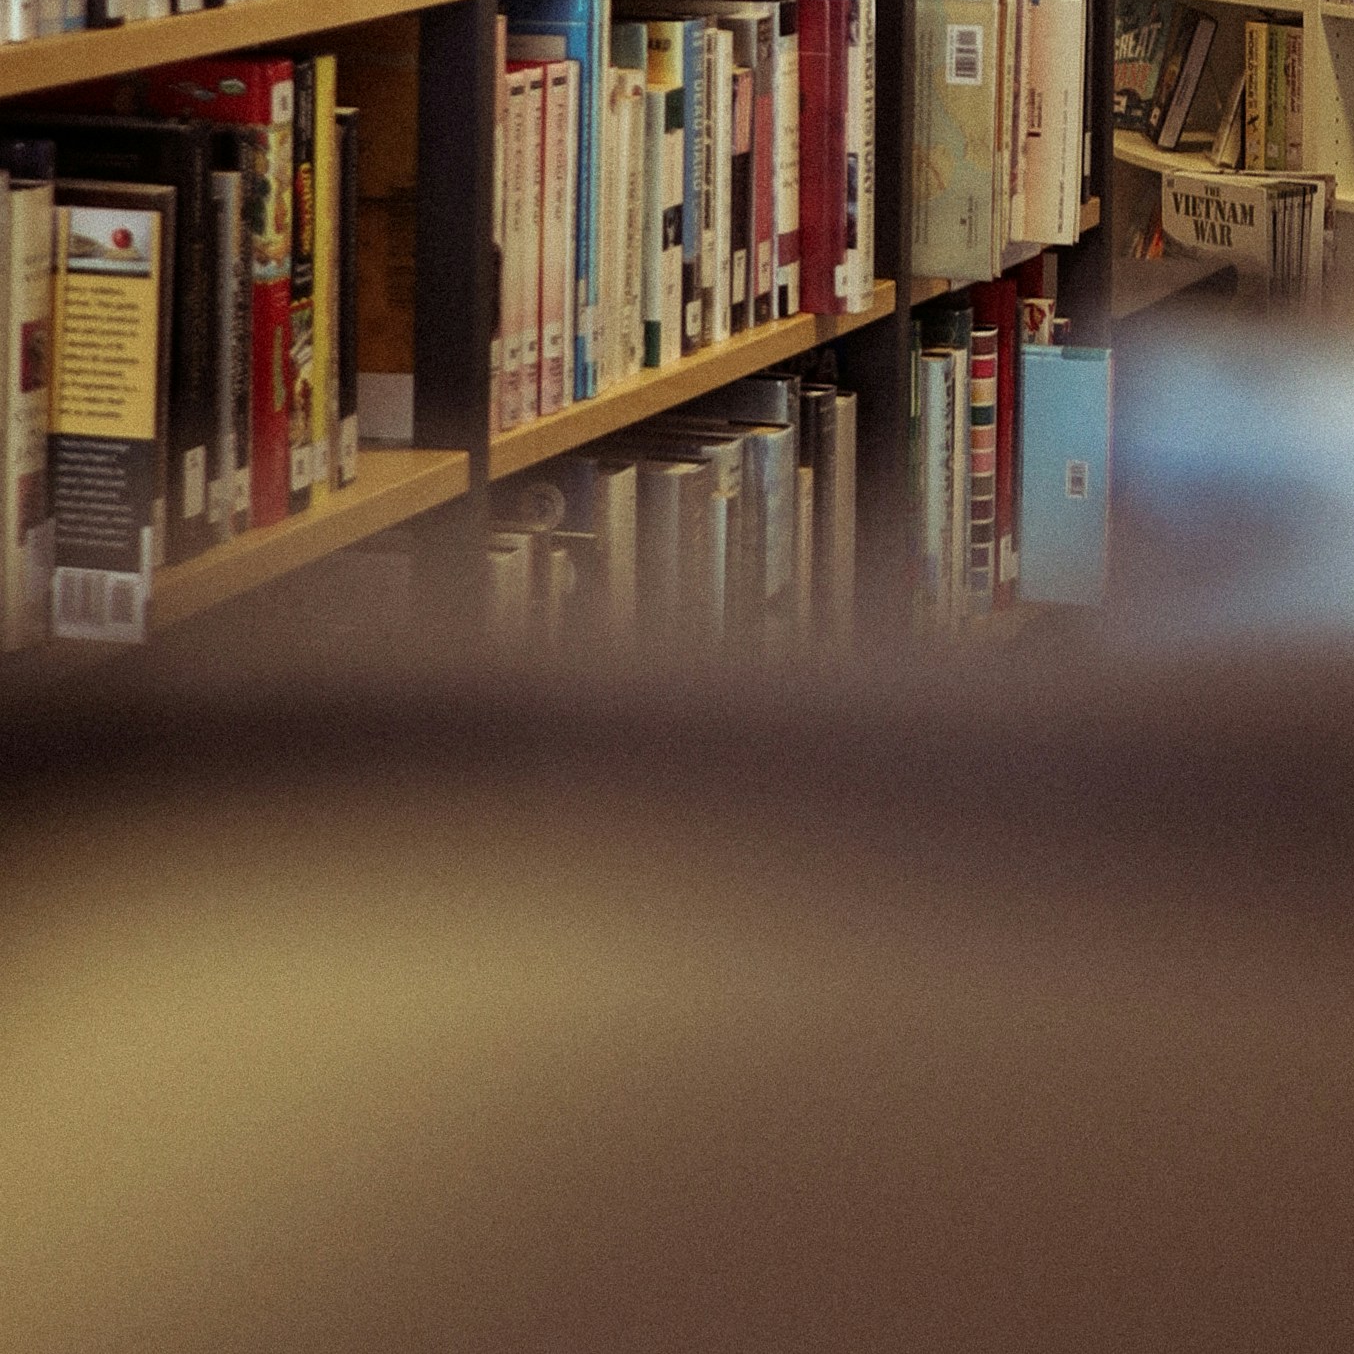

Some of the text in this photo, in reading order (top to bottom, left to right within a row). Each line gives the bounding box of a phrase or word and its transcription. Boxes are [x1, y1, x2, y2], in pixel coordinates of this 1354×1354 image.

[863, 97, 874, 194] HISTORY
[1204, 184, 1221, 197] THE
[1172, 191, 1255, 227] VIETNAM
[1192, 218, 1233, 247] WAR
